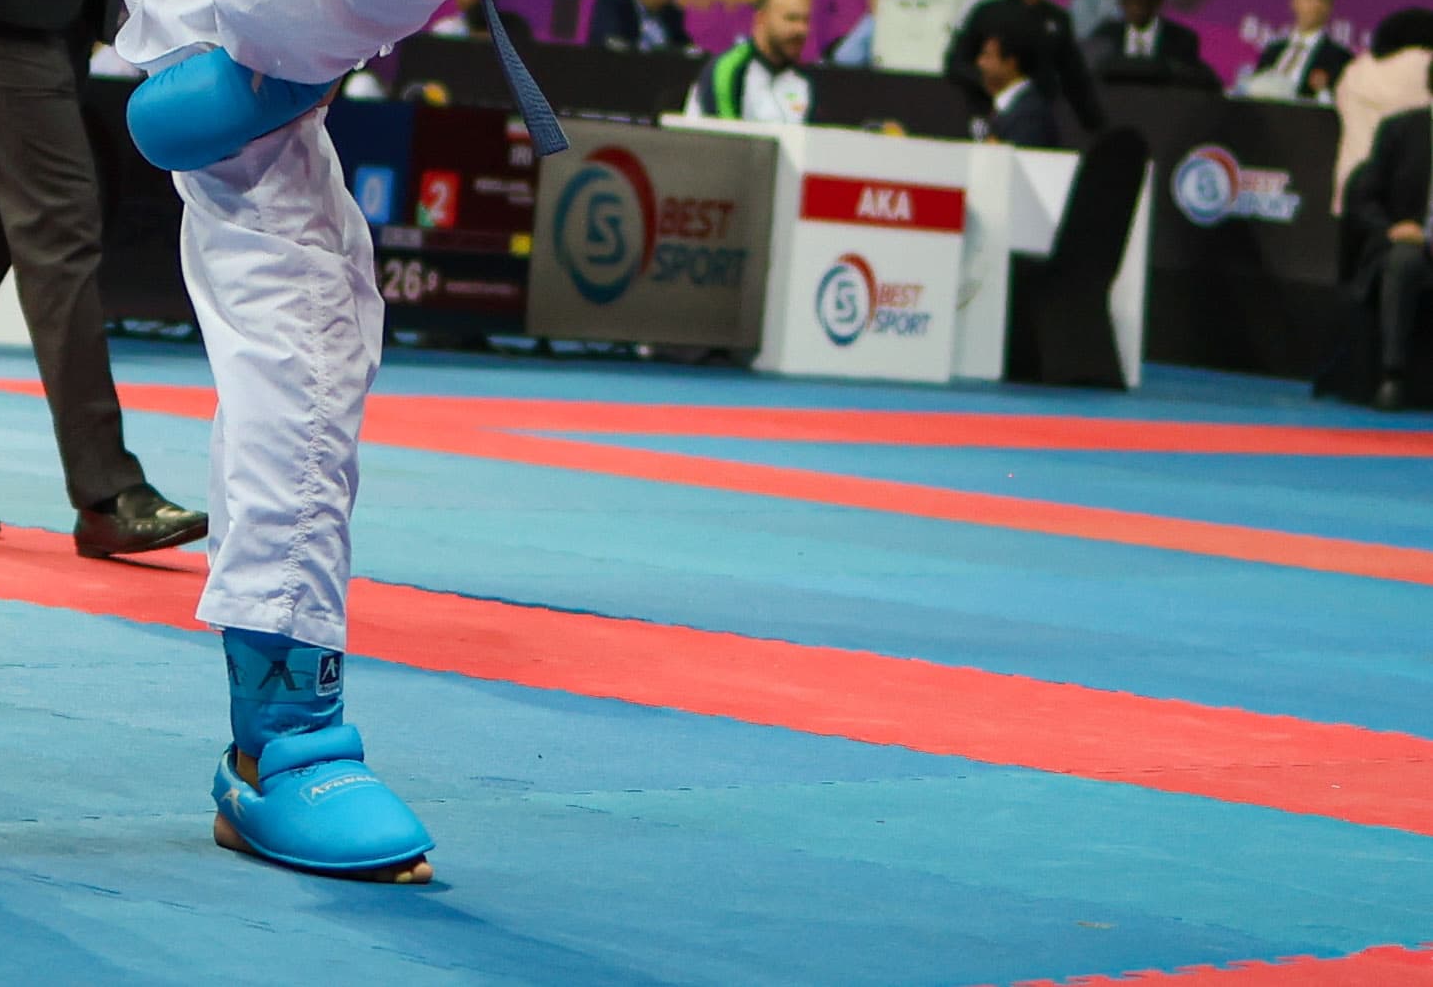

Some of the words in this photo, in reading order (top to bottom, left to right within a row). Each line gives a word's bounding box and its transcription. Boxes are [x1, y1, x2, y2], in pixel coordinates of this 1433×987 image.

[427, 181, 451, 220] 2
[661, 195, 736, 239] BEST
[857, 186, 913, 221] AKA
[651, 240, 750, 289] SPORT
[878, 283, 924, 309] BEST
[873, 310, 932, 337] SPORT
